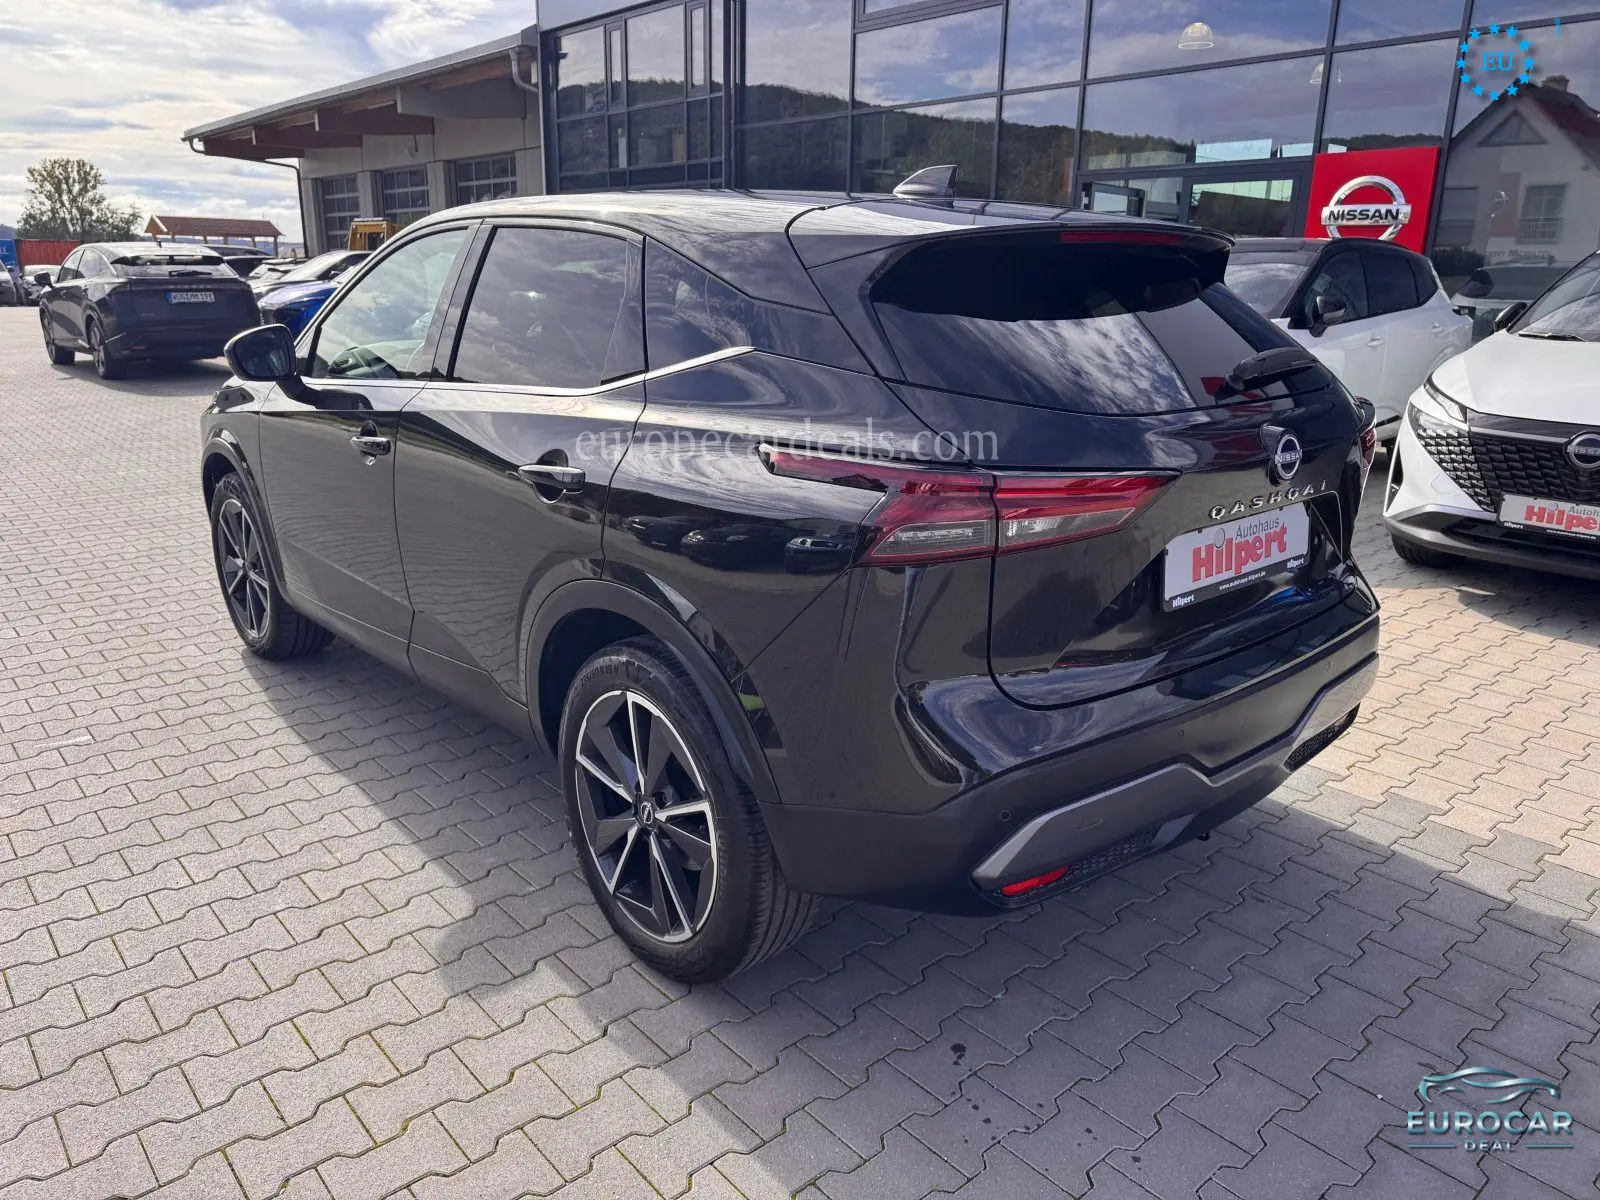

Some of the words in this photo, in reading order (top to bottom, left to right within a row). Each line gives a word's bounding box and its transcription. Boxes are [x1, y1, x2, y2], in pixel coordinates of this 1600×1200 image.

[1328, 208, 1400, 221] NISSAN
[1275, 449, 1302, 464] NISSAN
[1211, 480, 1325, 519] QASHQAI
[1235, 517, 1280, 541] Autohaus
[1192, 527, 1287, 582] Hilpert
[1172, 594, 1195, 608] Hilpert
